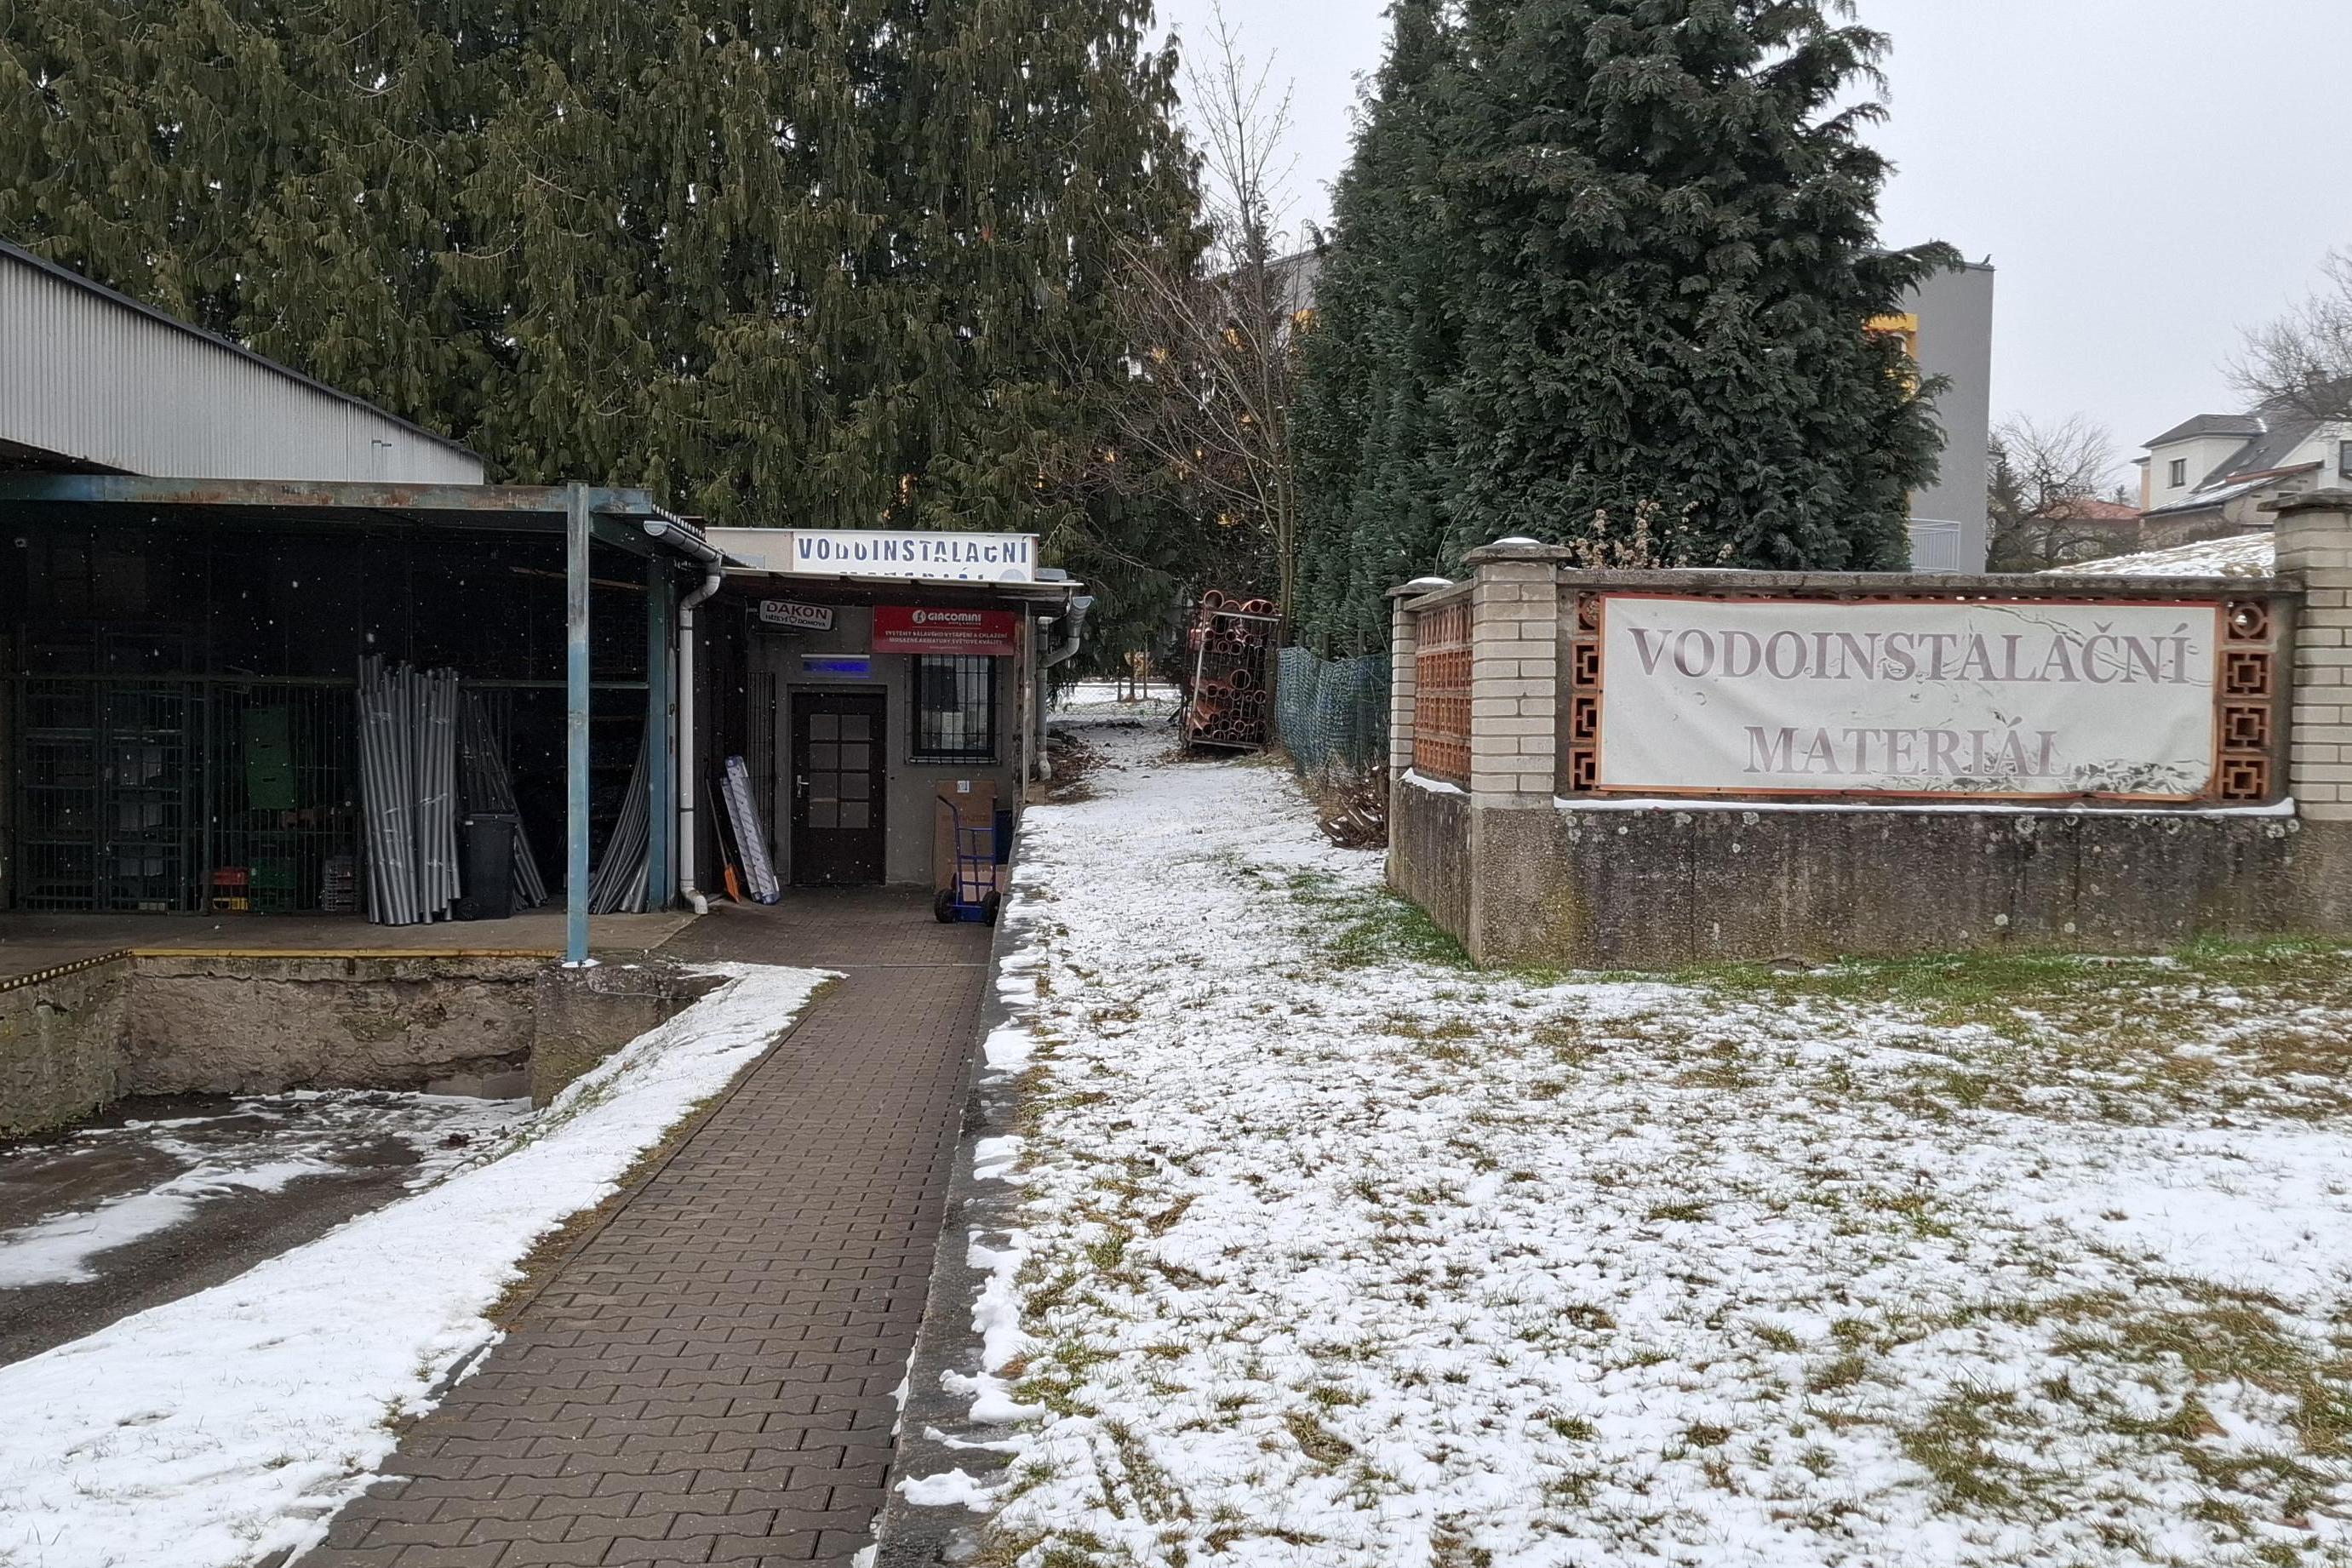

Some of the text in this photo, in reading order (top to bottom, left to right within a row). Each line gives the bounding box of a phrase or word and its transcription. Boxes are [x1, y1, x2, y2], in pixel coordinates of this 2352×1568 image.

[767, 602, 827, 620] DAKON
[928, 612, 981, 621] GIACOMINI
[1627, 621, 2191, 684] VODOINSTALAČNÍ
[1743, 717, 2071, 778] MATERIÁL
